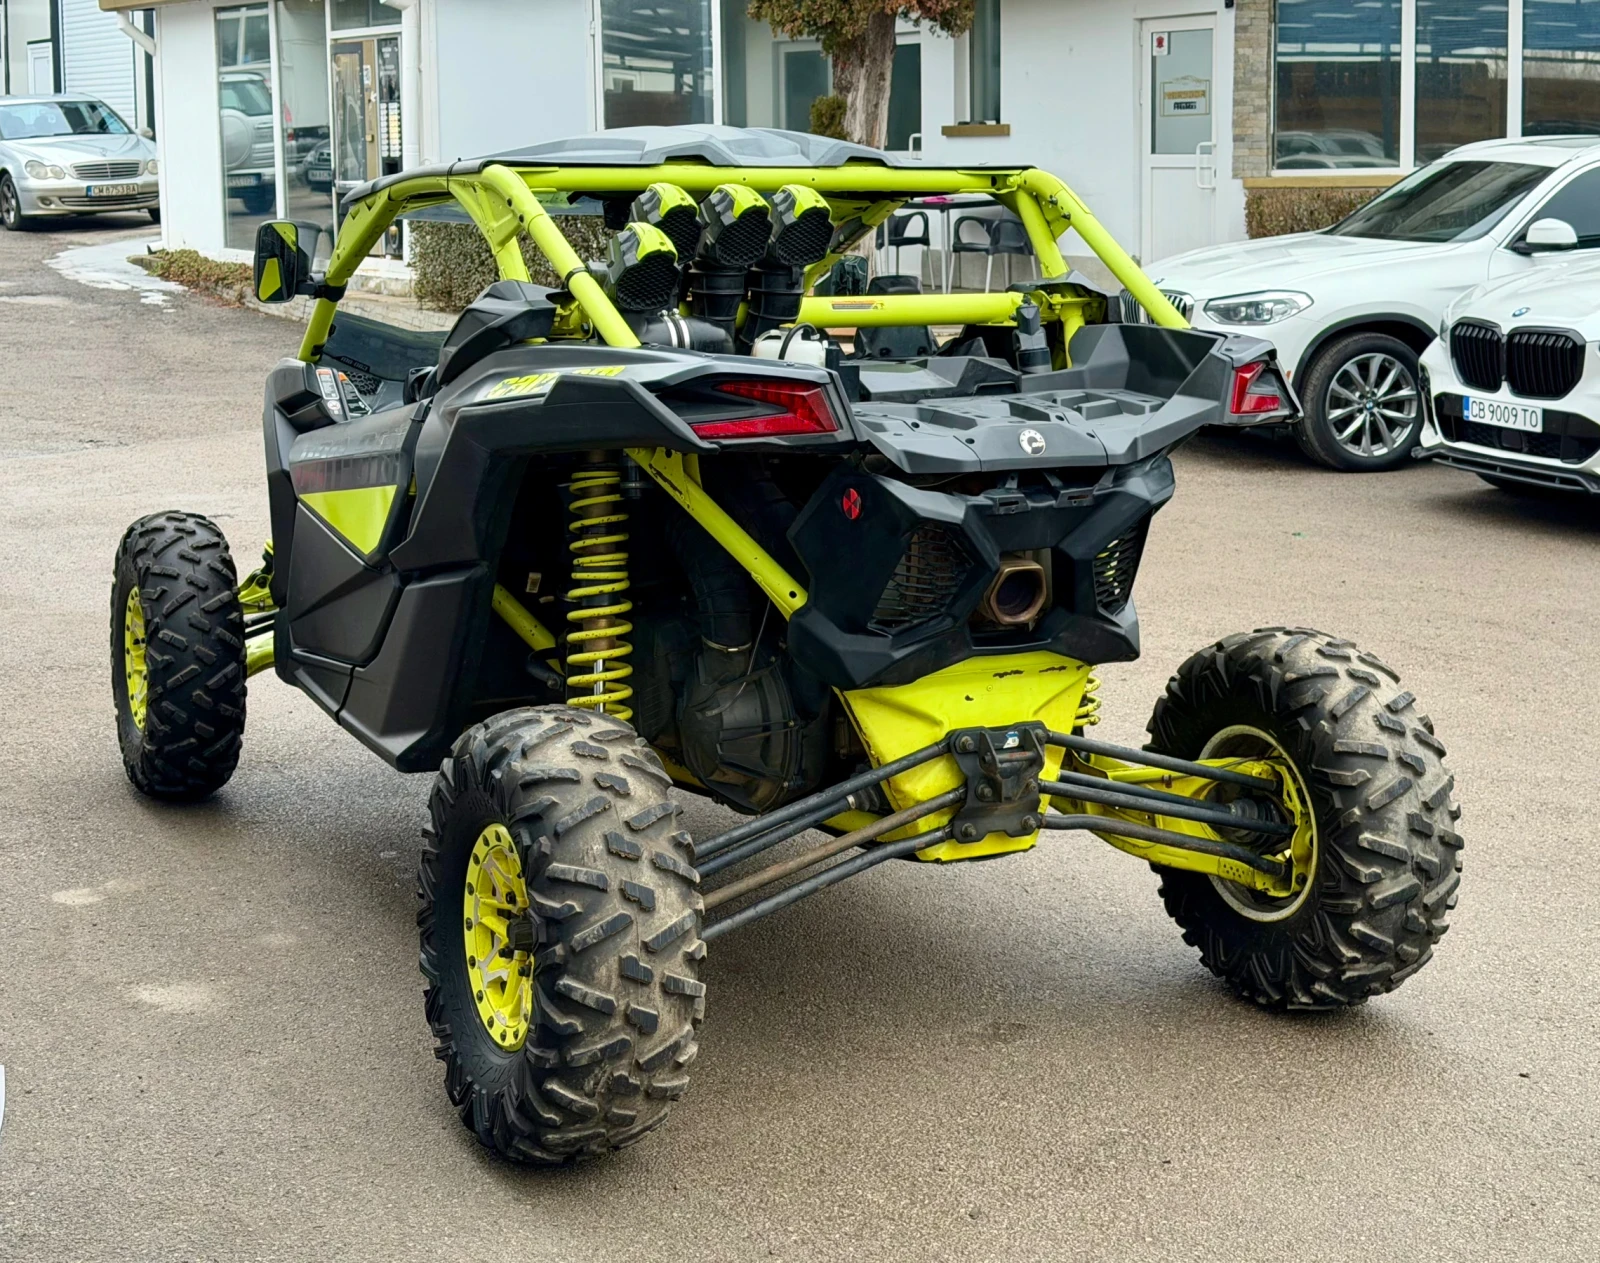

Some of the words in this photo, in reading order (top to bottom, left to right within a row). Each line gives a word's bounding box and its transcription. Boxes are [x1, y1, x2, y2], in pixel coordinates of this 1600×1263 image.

[1471, 400, 1486, 419] CB
[1487, 403, 1518, 425] 9009
[1520, 408, 1539, 428] TO
